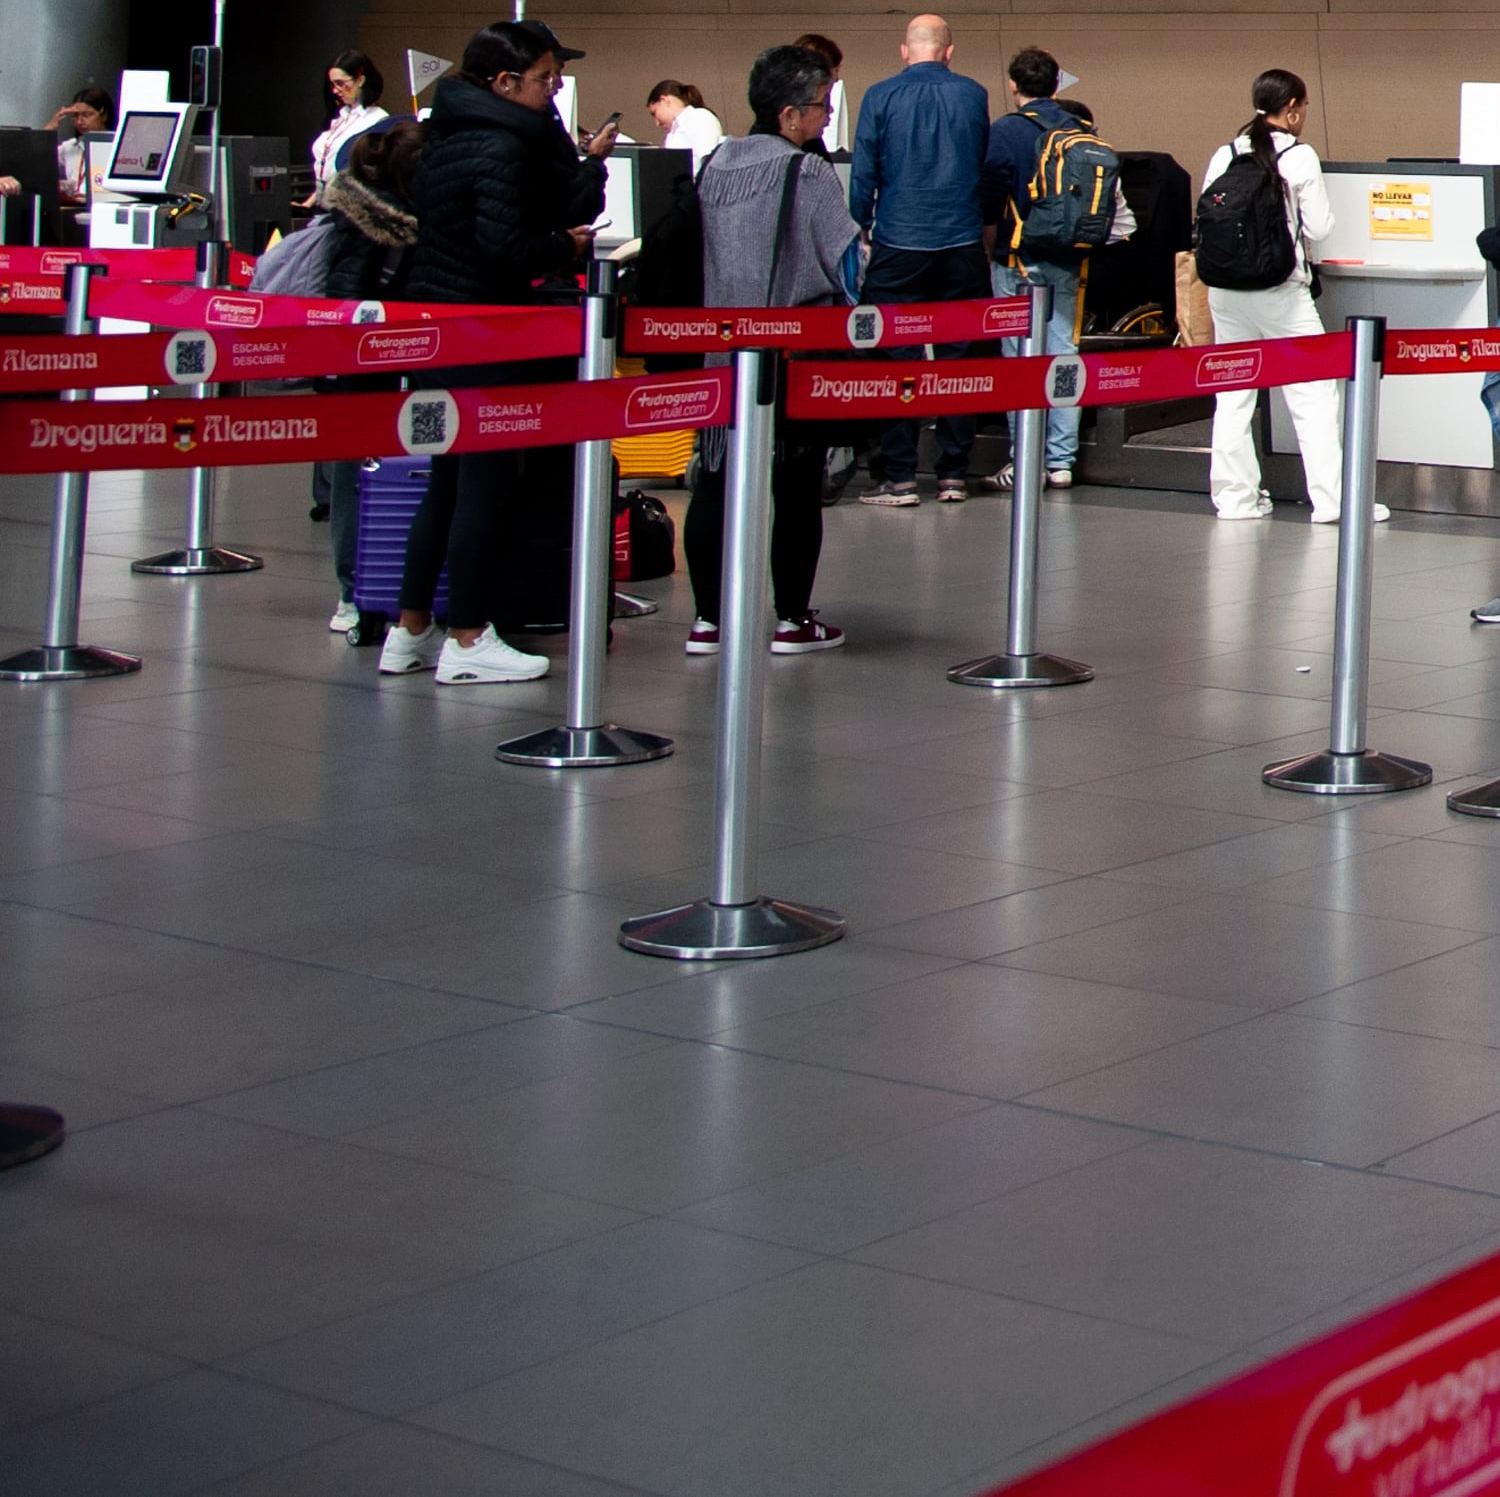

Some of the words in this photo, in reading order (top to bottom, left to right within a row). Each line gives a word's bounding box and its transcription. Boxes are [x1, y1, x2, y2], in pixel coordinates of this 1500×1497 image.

[12, 283, 60, 299] Alemana
[643, 318, 717, 339] Droguería
[737, 318, 801, 335] Alemana
[233, 343, 278, 353] ESCANEA
[281, 342, 287, 351] Y
[378, 347, 428, 359] virtual.com
[1397, 340, 1457, 362] Droguería
[3, 349, 98, 371] Alemana
[233, 355, 286, 366] DESCUBRE
[1099, 367, 1135, 377] ESCANEA
[1137, 366, 1142, 374] Y
[811, 375, 896, 402] Droguería
[919, 374, 993, 395] Alemana
[1099, 378, 1140, 390] DESCUBRE
[479, 404, 531, 418] ESCANEA
[535, 404, 542, 414] Y
[650, 404, 707, 419] virtual.com
[480, 419, 541, 433] DESCUBRE
[30, 417, 167, 453] Droguería
[203, 415, 318, 442] Alemana
